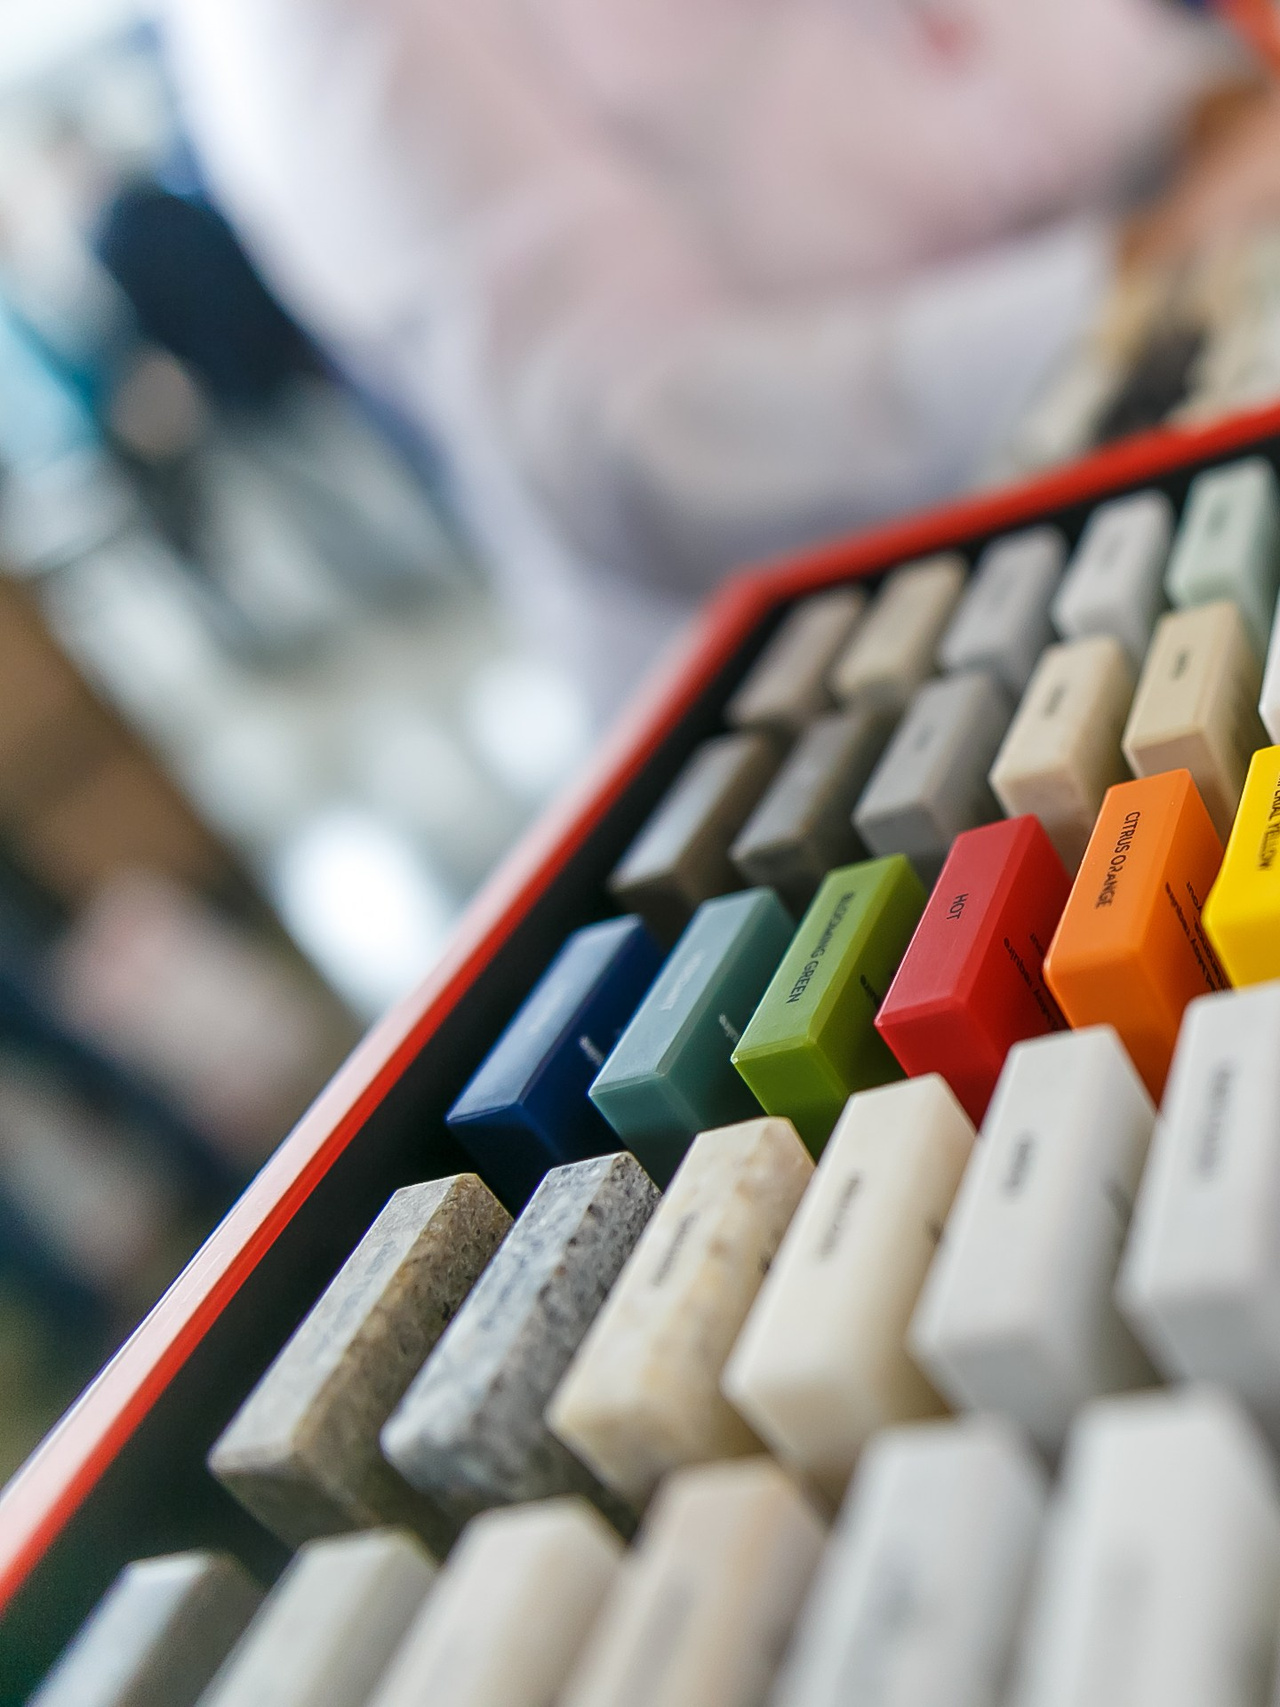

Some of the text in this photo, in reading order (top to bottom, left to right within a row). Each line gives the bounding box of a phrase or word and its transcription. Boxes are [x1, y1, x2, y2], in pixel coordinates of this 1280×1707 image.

[1095, 811, 1141, 910] CITRUS ORANGE
[946, 893, 969, 920] HOT
[786, 960, 819, 1004] GREEN
